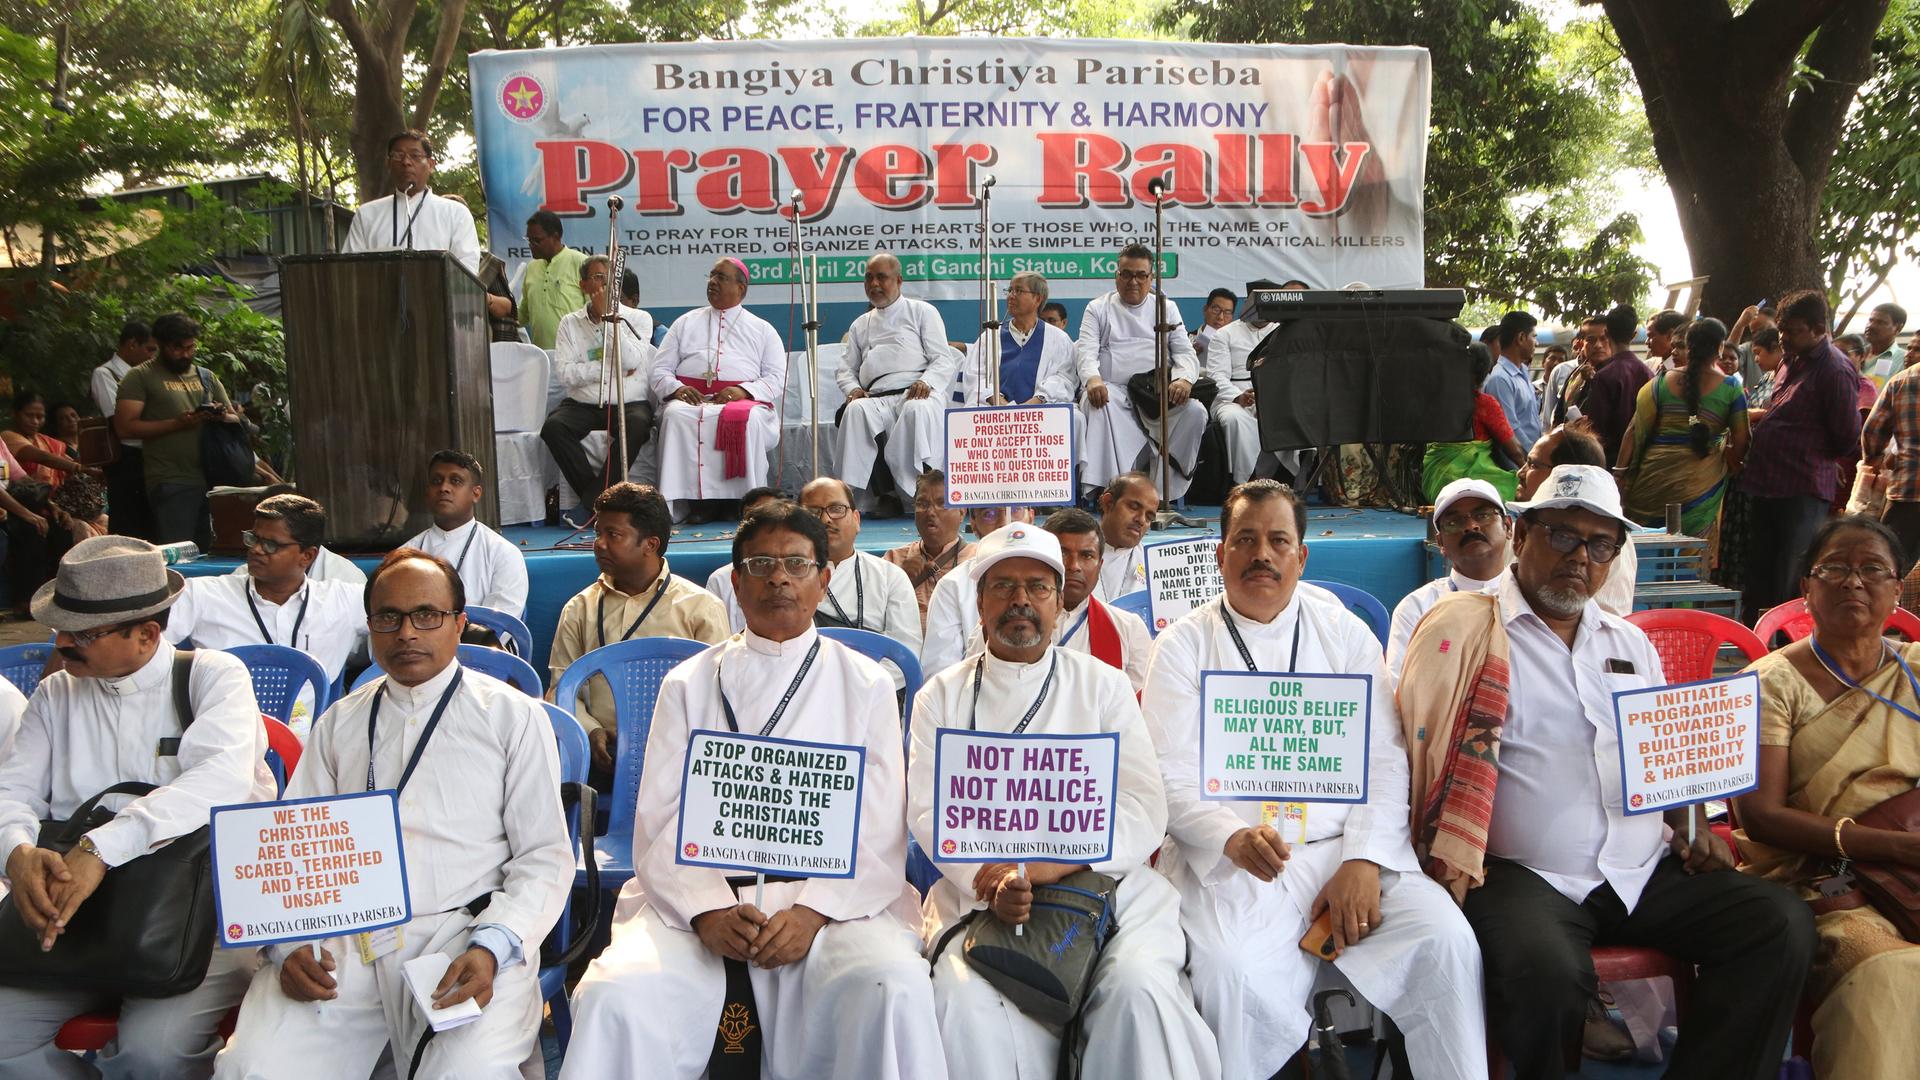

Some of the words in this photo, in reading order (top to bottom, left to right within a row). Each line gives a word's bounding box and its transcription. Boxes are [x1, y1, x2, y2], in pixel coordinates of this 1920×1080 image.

[654, 61, 833, 95] Bangiya
[850, 57, 1058, 92] Christiya
[1073, 58, 1262, 86] Pariseba
[643, 106, 711, 134] FOR
[722, 104, 843, 134] PEACE,
[855, 101, 1060, 129] FRATERNITY
[1070, 102, 1092, 128] &
[1103, 102, 1268, 128] HARMONY
[535, 139, 998, 223] Prayer
[1036, 132, 1370, 219] Rally
[625, 229, 650, 240] TO
[656, 228, 704, 240] PRAY
[710, 227, 748, 239] FOR
[754, 226, 790, 238] THE
[799, 225, 874, 237] CHANGE
[881, 224, 905, 235] OF
[911, 222, 986, 235] HEARTS
[991, 222, 1016, 233] OF
[1021, 222, 1087, 233] THOSE
[1089, 221, 1138, 234] WHO,
[1167, 221, 1202, 232] THE
[1208, 221, 1260, 232] NAME
[1266, 221, 1289, 232] OF
[687, 241, 767, 254] HATRED,
[773, 239, 869, 253] ORGANIZE
[875, 238, 963, 250] ATTACKS,
[969, 237, 1022, 249] MAKE
[1028, 237, 1095, 248] SIMPLE
[1101, 236, 1173, 247] PEOPLE
[1179, 236, 1221, 247] INTO
[1226, 235, 1325, 247] FANATICAL
[1331, 236, 1405, 247] KILLERS
[906, 261, 925, 275] at
[931, 258, 1005, 276] Gandhi
[1012, 257, 1083, 276] Statue,
[1270, 292, 1304, 302] YAMAHA
[973, 412, 1011, 424] CHURCH
[1014, 411, 1044, 422] NEVER
[975, 423, 1042, 436] PROSELYTIZES.
[954, 438, 968, 448] WE
[971, 437, 993, 448] ONLY
[996, 436, 1032, 447] ACCEPT
[1034, 435, 1065, 446] THOSE
[967, 449, 989, 460] WHO
[991, 448, 1018, 459] COME
[1021, 448, 1032, 458] TO
[1036, 447, 1051, 458] US.
[950, 461, 979, 473] THERE
[982, 461, 990, 471] IS
[994, 460, 1006, 471] NO
[1008, 459, 1054, 472] QUESTION
[1057, 459, 1070, 469] OF
[951, 473, 994, 485] SHOWING
[996, 472, 1019, 483] FEAR
[1022, 472, 1035, 482] OR
[1038, 471, 1069, 482] GREED
[964, 491, 996, 501] BANGIYA
[996, 489, 1033, 500] CHRISTIYA
[1034, 488, 1069, 499] PARISEBA
[1158, 544, 1190, 557] THOSE
[1193, 543, 1217, 553] WHO
[1187, 553, 1217, 565] DIVISI
[1153, 566, 1190, 580] AMONG
[1194, 564, 1219, 575] PEOP
[1162, 577, 1191, 590] NAME
[1195, 576, 1208, 587] OF
[1159, 590, 1179, 601] ARE
[1182, 588, 1201, 599] THE
[1269, 681, 1303, 697] OUR
[1655, 684, 1729, 707] INITIATE
[1214, 699, 1298, 716] RELIGIOUS
[1303, 701, 1358, 718] BELIEF
[1628, 694, 1753, 726] PROGRAMMES
[1224, 717, 1258, 733] MAY
[1263, 718, 1306, 737] VARY,
[1312, 719, 1346, 738] BUT,
[1651, 712, 1735, 738] TOWARDS
[1249, 736, 1277, 752] ALL
[1283, 737, 1319, 753] MEN
[1638, 730, 1720, 755] BUILDING
[1726, 724, 1747, 739] UP
[704, 740, 746, 760] STOP
[751, 746, 847, 771] ORGANIZED
[967, 744, 1014, 771] NOT
[1023, 747, 1090, 776] HATE,
[1225, 754, 1255, 770] ARE
[1261, 755, 1292, 771] THE
[1297, 756, 1343, 773] SAME
[1643, 739, 1744, 769] FRATERNITY
[692, 759, 765, 782] ATTACKS
[770, 768, 782, 785] &
[788, 770, 855, 791] HATRED
[1644, 770, 1656, 784] &
[1663, 753, 1745, 780] HARMONY
[712, 781, 793, 805] TOWARDS
[799, 791, 831, 808] THE
[950, 775, 997, 801] NOT
[1006, 778, 1103, 806] MALICE,
[1224, 779, 1264, 792] BANGIYA
[1264, 780, 1314, 794] CHRISTIYA
[1315, 782, 1360, 795] PARISEBA
[1646, 790, 1681, 804] BANGIYA
[1680, 780, 1723, 798] CHRISTIYA
[1723, 773, 1754, 789] PARISEBA
[273, 809, 296, 825] WE
[301, 806, 330, 822] THE
[719, 801, 820, 827] CHRISTIANS
[945, 805, 1039, 832] SPREAD
[1048, 809, 1106, 833] LOVE
[259, 820, 350, 843] CHRISTIANS
[713, 820, 725, 836] &
[731, 822, 824, 846] CHURCHES
[258, 845, 286, 861] ARE
[291, 837, 356, 858] GETTING
[702, 845, 745, 861] BANGIYA
[747, 849, 798, 866] CHRISTIYA
[800, 856, 847, 870] PARISEBA
[960, 841, 1003, 854] BANGIYA
[1005, 842, 1058, 855] CHRISTIYA
[1060, 841, 1105, 856] PARISEBA
[235, 861, 299, 880] SCARED,
[302, 850, 383, 873] TERRIFIED
[261, 879, 292, 895] AND
[296, 870, 360, 891] FEELING
[282, 889, 342, 909] UNSAFE
[247, 920, 293, 937] BANGIYA
[295, 914, 351, 931] CHRISTIYA
[352, 905, 403, 924] PARISEBA
